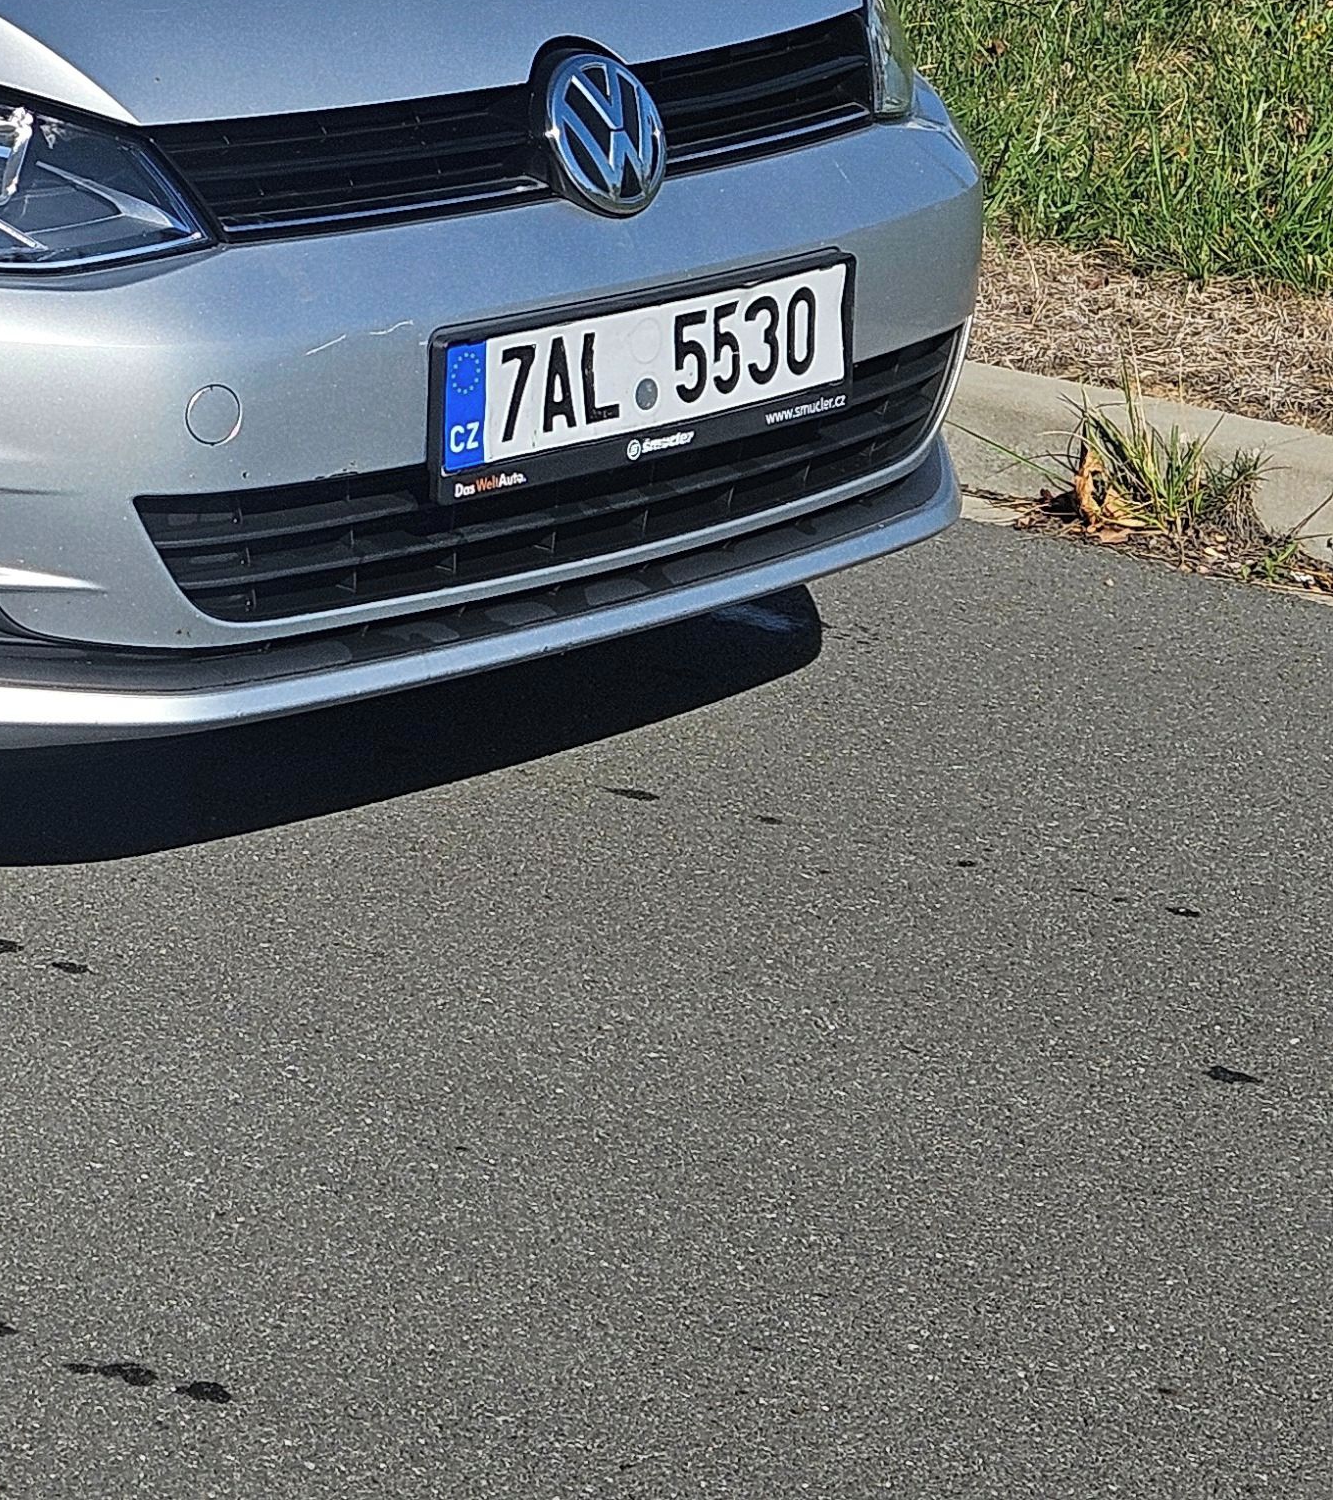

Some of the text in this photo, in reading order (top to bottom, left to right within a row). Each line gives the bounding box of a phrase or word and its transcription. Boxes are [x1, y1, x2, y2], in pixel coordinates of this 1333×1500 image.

[500, 286, 817, 443] 7AL 5530
[765, 394, 847, 426] www.smucler.cz
[449, 421, 480, 454] CZ
[454, 482, 476, 498] Das
